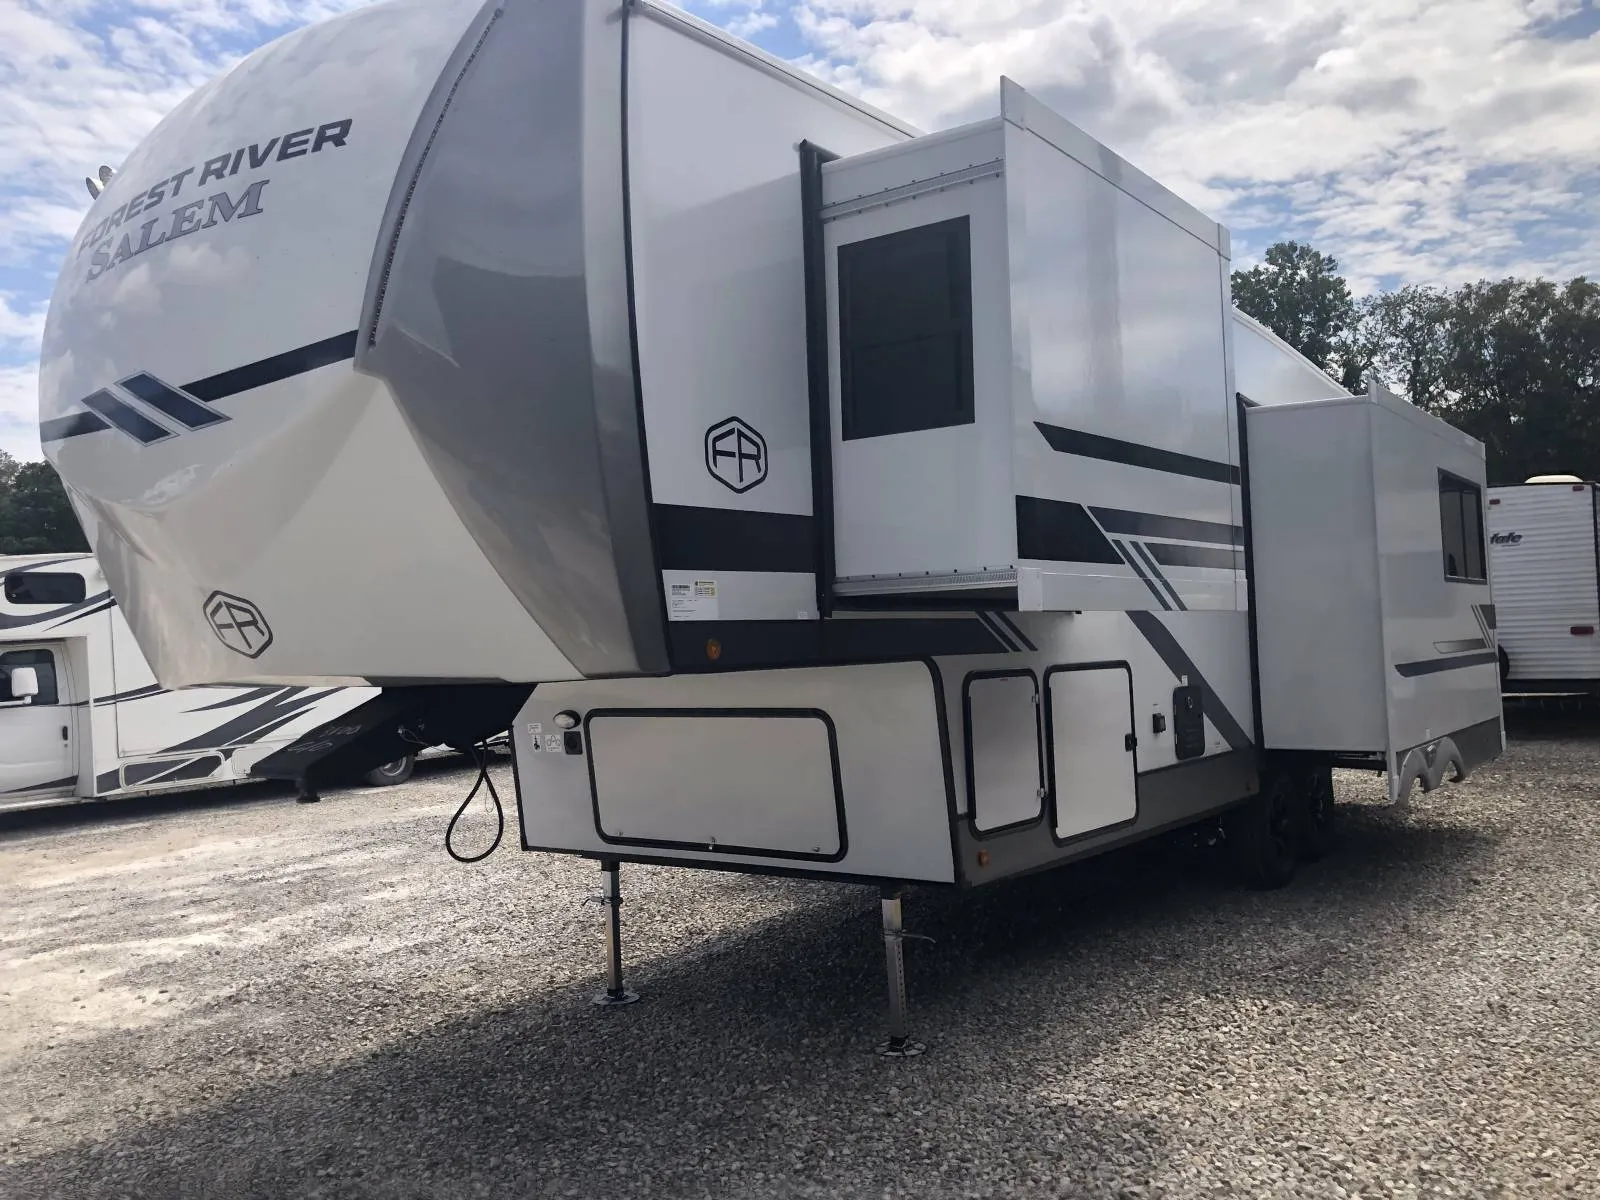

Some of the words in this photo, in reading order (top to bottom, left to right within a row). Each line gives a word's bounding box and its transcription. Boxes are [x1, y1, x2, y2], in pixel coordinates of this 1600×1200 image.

[77, 166, 195, 259] FOREST
[198, 119, 352, 187] RIVER
[86, 179, 271, 282] SALEM
